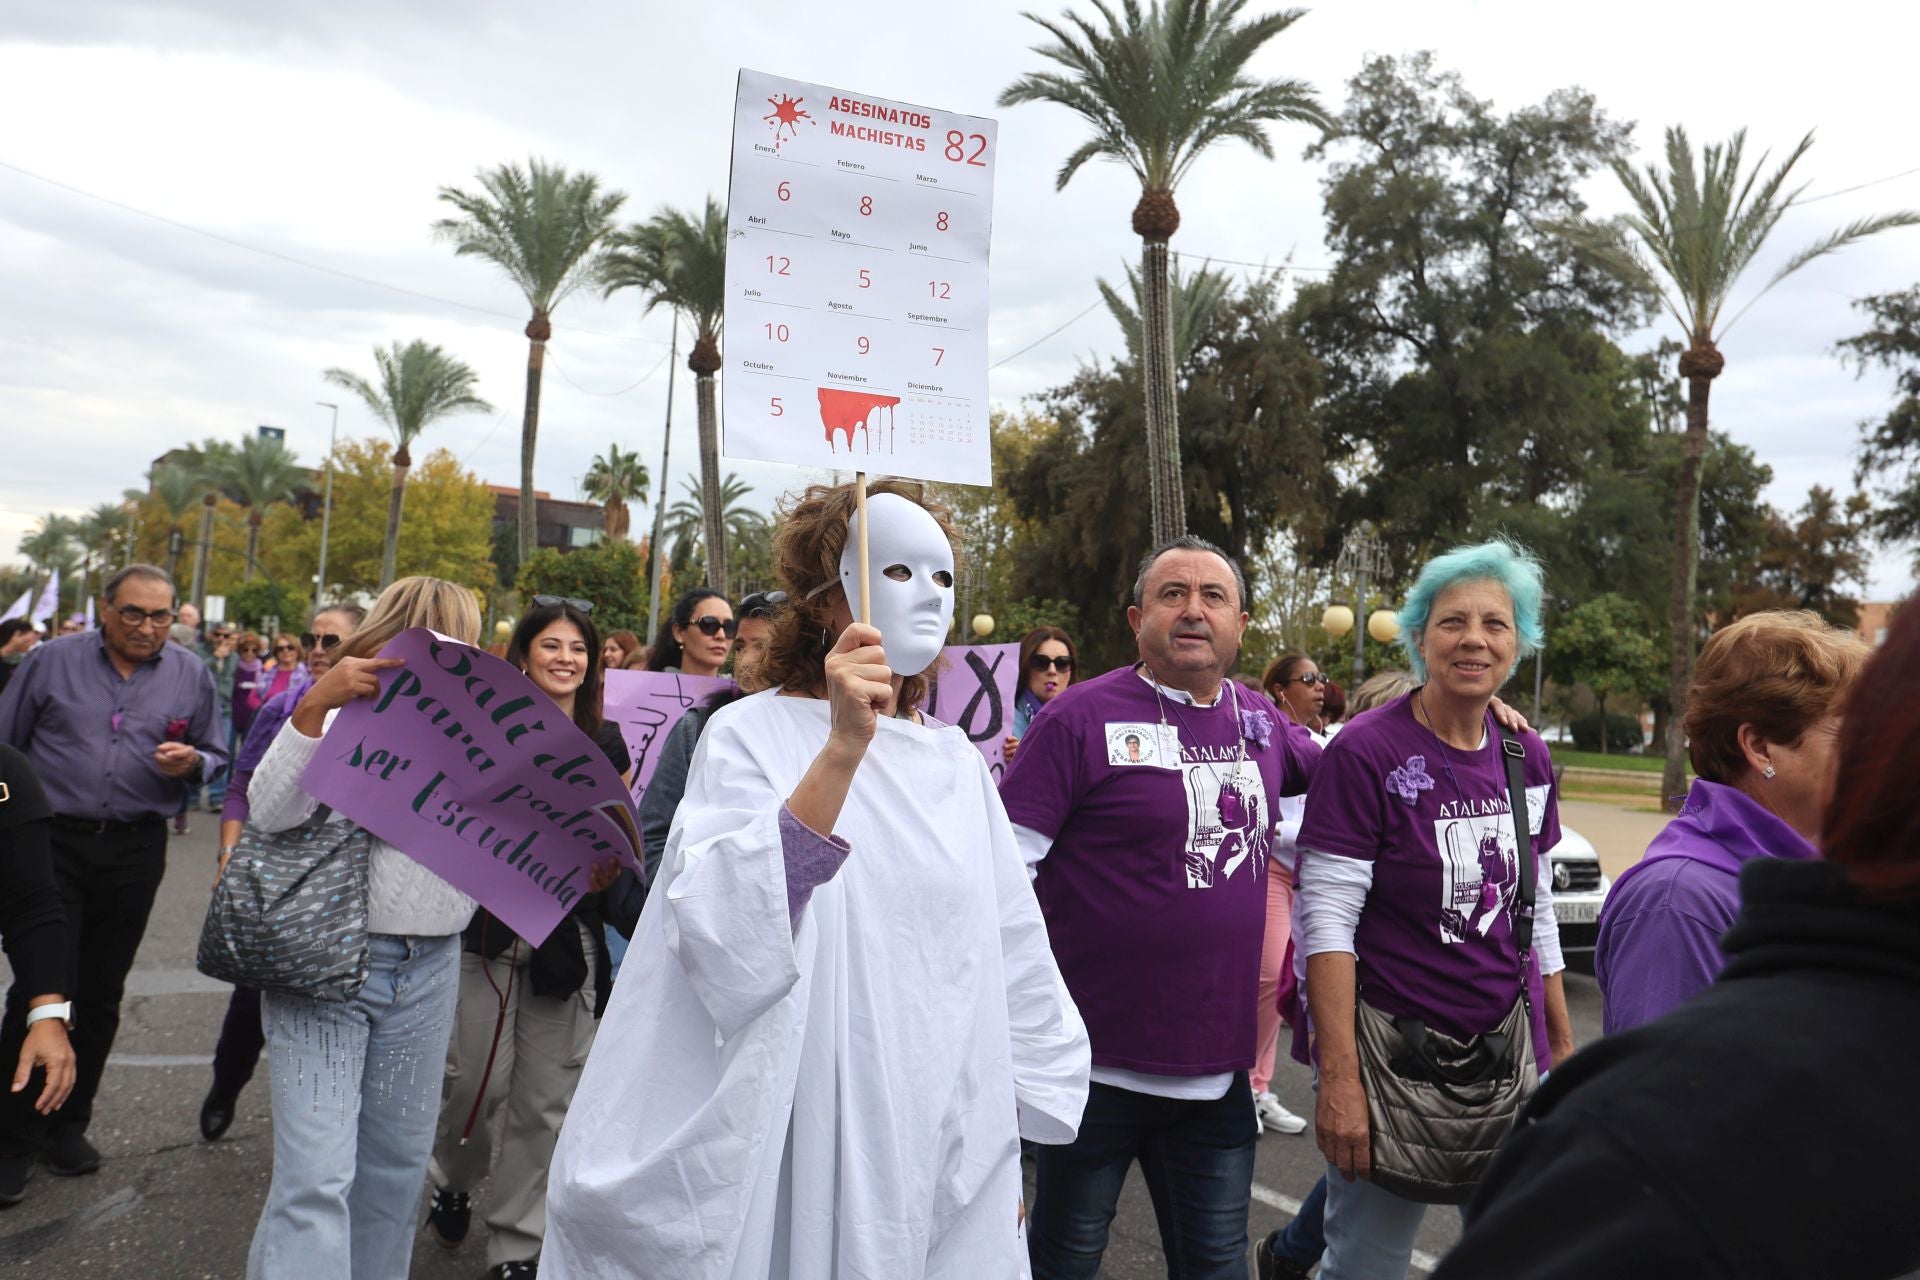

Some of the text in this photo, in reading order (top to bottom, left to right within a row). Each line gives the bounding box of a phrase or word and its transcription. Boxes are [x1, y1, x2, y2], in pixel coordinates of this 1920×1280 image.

[829, 96, 931, 129] ASESINATOS
[830, 121, 925, 151] MACHISTAS
[755, 144, 776, 154] Enero
[945, 130, 987, 167] 82
[837, 160, 865, 170] Febrero
[916, 174, 937, 184] Marzo
[777, 181, 790, 201] 6
[860, 196, 872, 216] 8
[748, 216, 766, 224] Abril
[936, 212, 949, 231] 8
[831, 230, 851, 240] Mayo
[909, 243, 927, 251] Junio
[766, 255, 790, 275] 12
[859, 270, 871, 288] 5
[744, 289, 761, 297] Julio
[928, 281, 951, 299] 12
[828, 301, 852, 310] Agosto
[908, 312, 948, 323] Septiembre
[765, 323, 789, 342] 10
[857, 336, 870, 354] 9
[744, 360, 774, 371] Octubre
[932, 348, 944, 366] 7
[828, 372, 867, 382] Noviembre
[908, 382, 943, 392] Diciembre
[770, 397, 783, 416] 5
[372, 669, 622, 856] para poder
[533, 753, 597, 790] de
[336, 736, 580, 911] ser Escuchada
